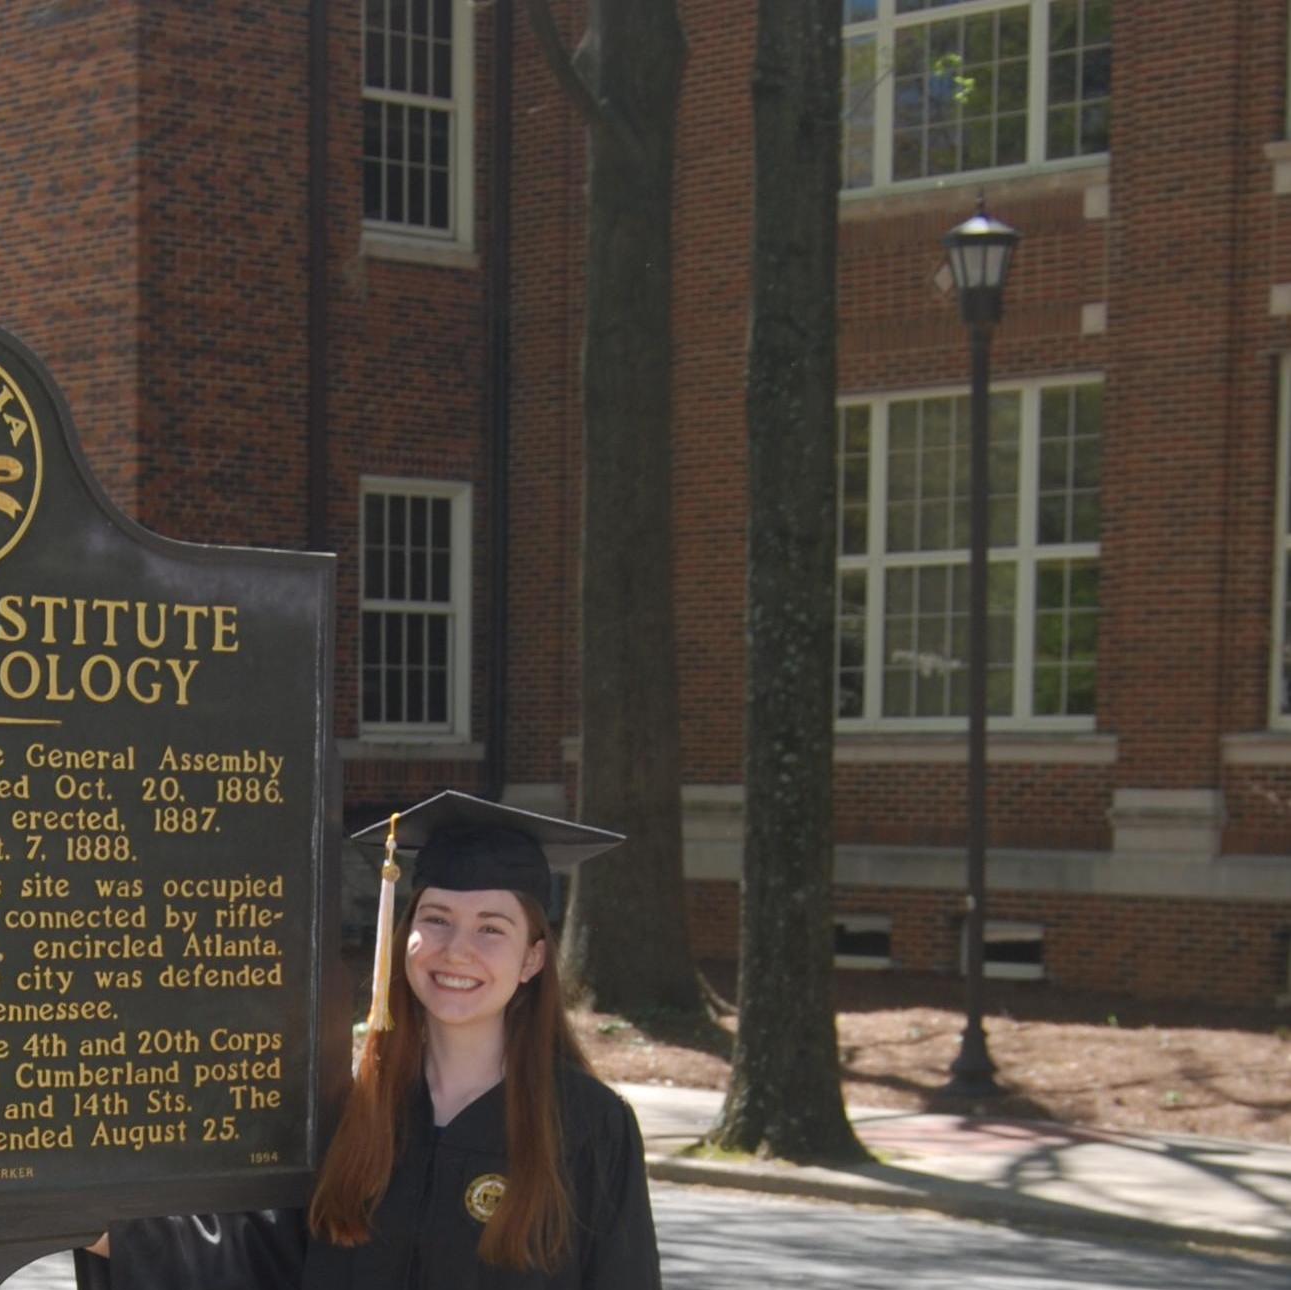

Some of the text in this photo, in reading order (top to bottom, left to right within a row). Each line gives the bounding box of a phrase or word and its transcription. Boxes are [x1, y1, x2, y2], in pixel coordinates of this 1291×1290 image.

[25, 743, 135, 771] General
[158, 745, 284, 779] Assembly
[55, 774, 113, 801] Oct.
[141, 776, 185, 802] 20,
[216, 776, 284, 804] 1886.
[11, 807, 126, 832] erected,
[154, 806, 221, 834] 1887.
[26, 834, 46, 862] 7,
[67, 834, 137, 862] 1888.
[20, 871, 70, 898] site
[94, 879, 143, 898] was
[163, 873, 283, 903] occupied
[4, 904, 146, 929] connected
[165, 904, 197, 934] by
[215, 903, 284, 928] rifle-
[33, 934, 164, 960] encircled
[182, 931, 283, 957] Atlanta.
[16, 964, 74, 995] city
[94, 969, 143, 989] was
[158, 962, 283, 988] defended
[22, 1032, 67, 1058] 4th
[79, 1031, 127, 1056] and
[137, 1029, 200, 1055] 20th
[209, 1028, 282, 1056] Corps
[15, 1060, 180, 1089] Cumberland
[194, 1057, 281, 1088] posted
[4, 1094, 54, 1120] and
[73, 1091, 129, 1117] 14th
[146, 1089, 193, 1114] Sts.
[229, 1084, 281, 1110] The
[90, 1121, 187, 1151] August
[202, 1116, 240, 1142] 25.
